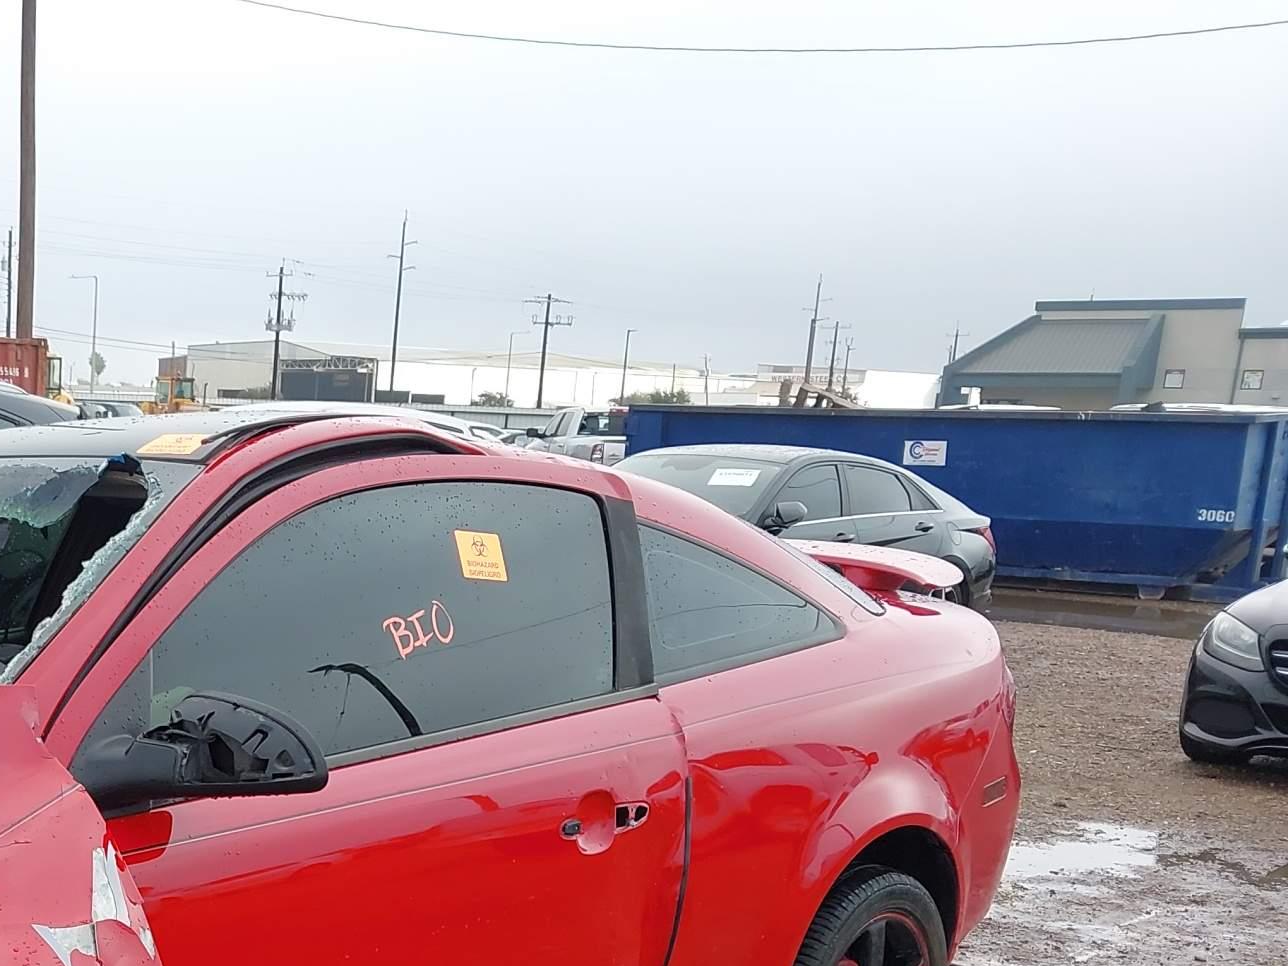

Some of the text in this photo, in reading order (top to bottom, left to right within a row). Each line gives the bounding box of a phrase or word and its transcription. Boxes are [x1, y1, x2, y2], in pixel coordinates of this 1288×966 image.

[810, 375, 832, 384] STEE
[1197, 508, 1236, 522] 3060
[466, 560, 499, 569] BIOHAZARD
[382, 600, 454, 660] BIO
